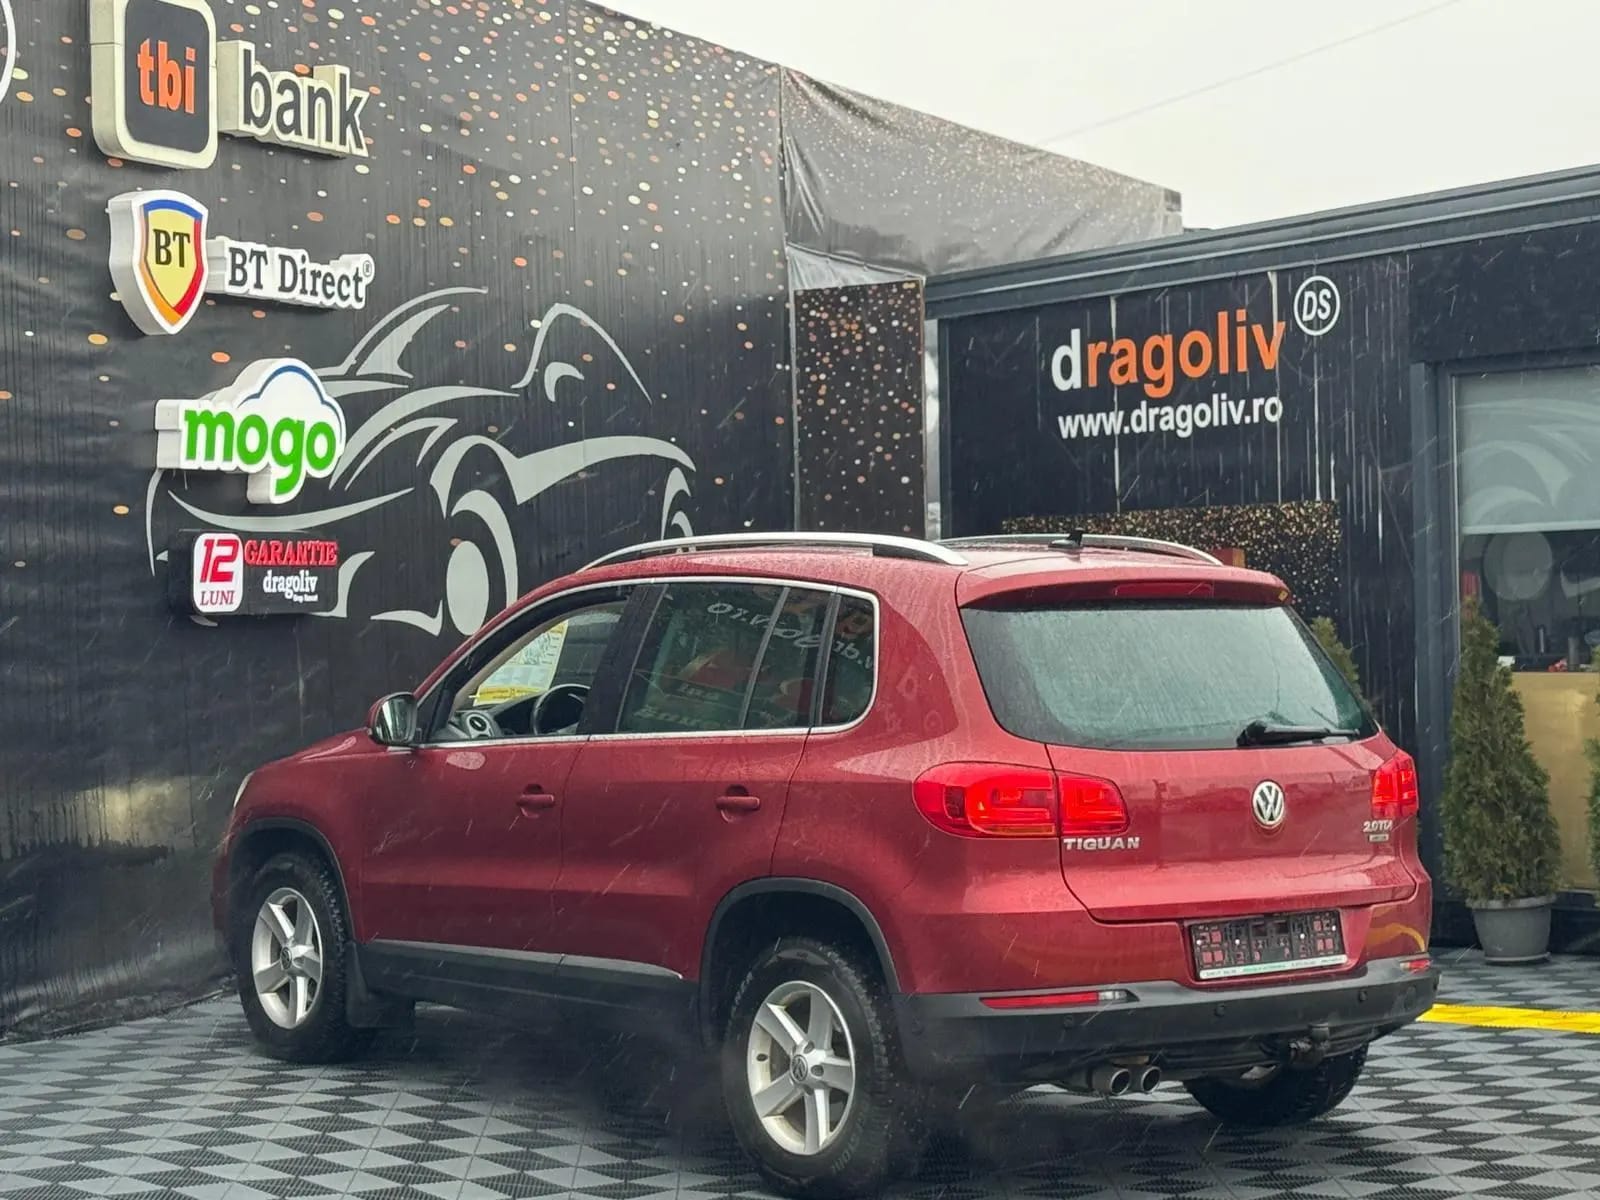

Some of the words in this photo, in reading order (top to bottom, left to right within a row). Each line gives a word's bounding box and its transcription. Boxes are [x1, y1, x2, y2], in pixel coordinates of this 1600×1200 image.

[137, 38, 197, 114] tbi
[243, 48, 366, 154] bank
[153, 229, 191, 268] BT
[229, 246, 268, 290] BT
[1302, 288, 1332, 322] DS
[1051, 308, 1286, 398] dragoliv
[1058, 393, 1284, 439] www.dragoliv.ro
[184, 409, 337, 496] mogo
[200, 539, 240, 583] 12
[245, 540, 338, 567] GARANTIE
[200, 590, 235, 606] LUNI
[263, 569, 319, 600] dragoliv
[1063, 836, 1140, 852] TIGUAN
